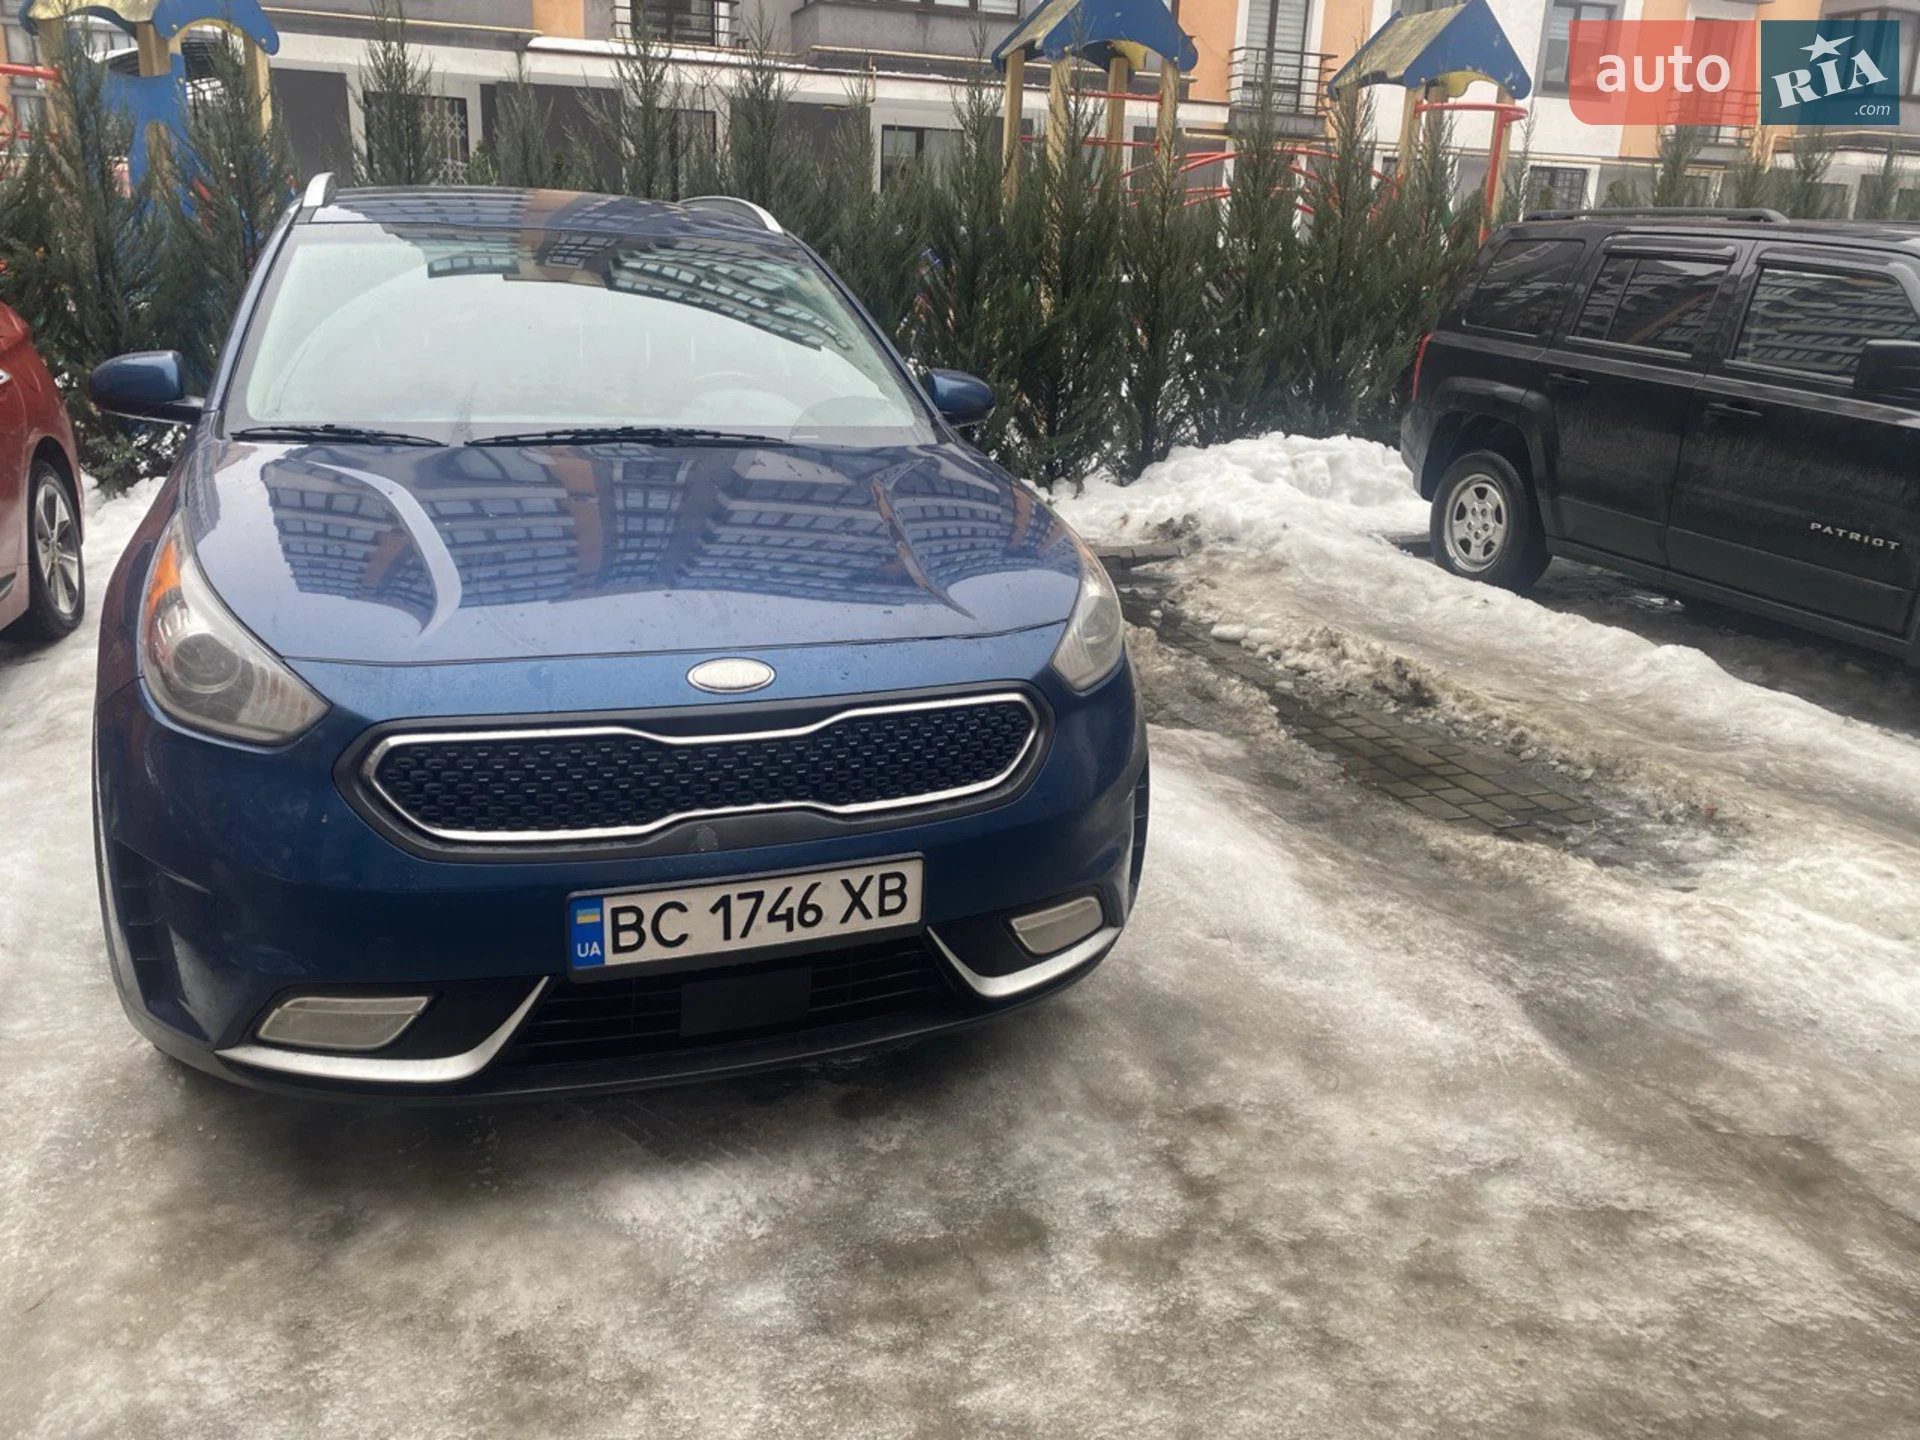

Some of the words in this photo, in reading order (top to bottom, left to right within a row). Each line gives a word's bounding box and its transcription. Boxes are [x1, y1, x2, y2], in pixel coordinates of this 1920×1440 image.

[1809, 522, 1900, 550] PATRIOT
[610, 901, 689, 955] BC
[708, 881, 823, 941] 1746
[839, 870, 908, 924] XB
[576, 941, 602, 958] UA
